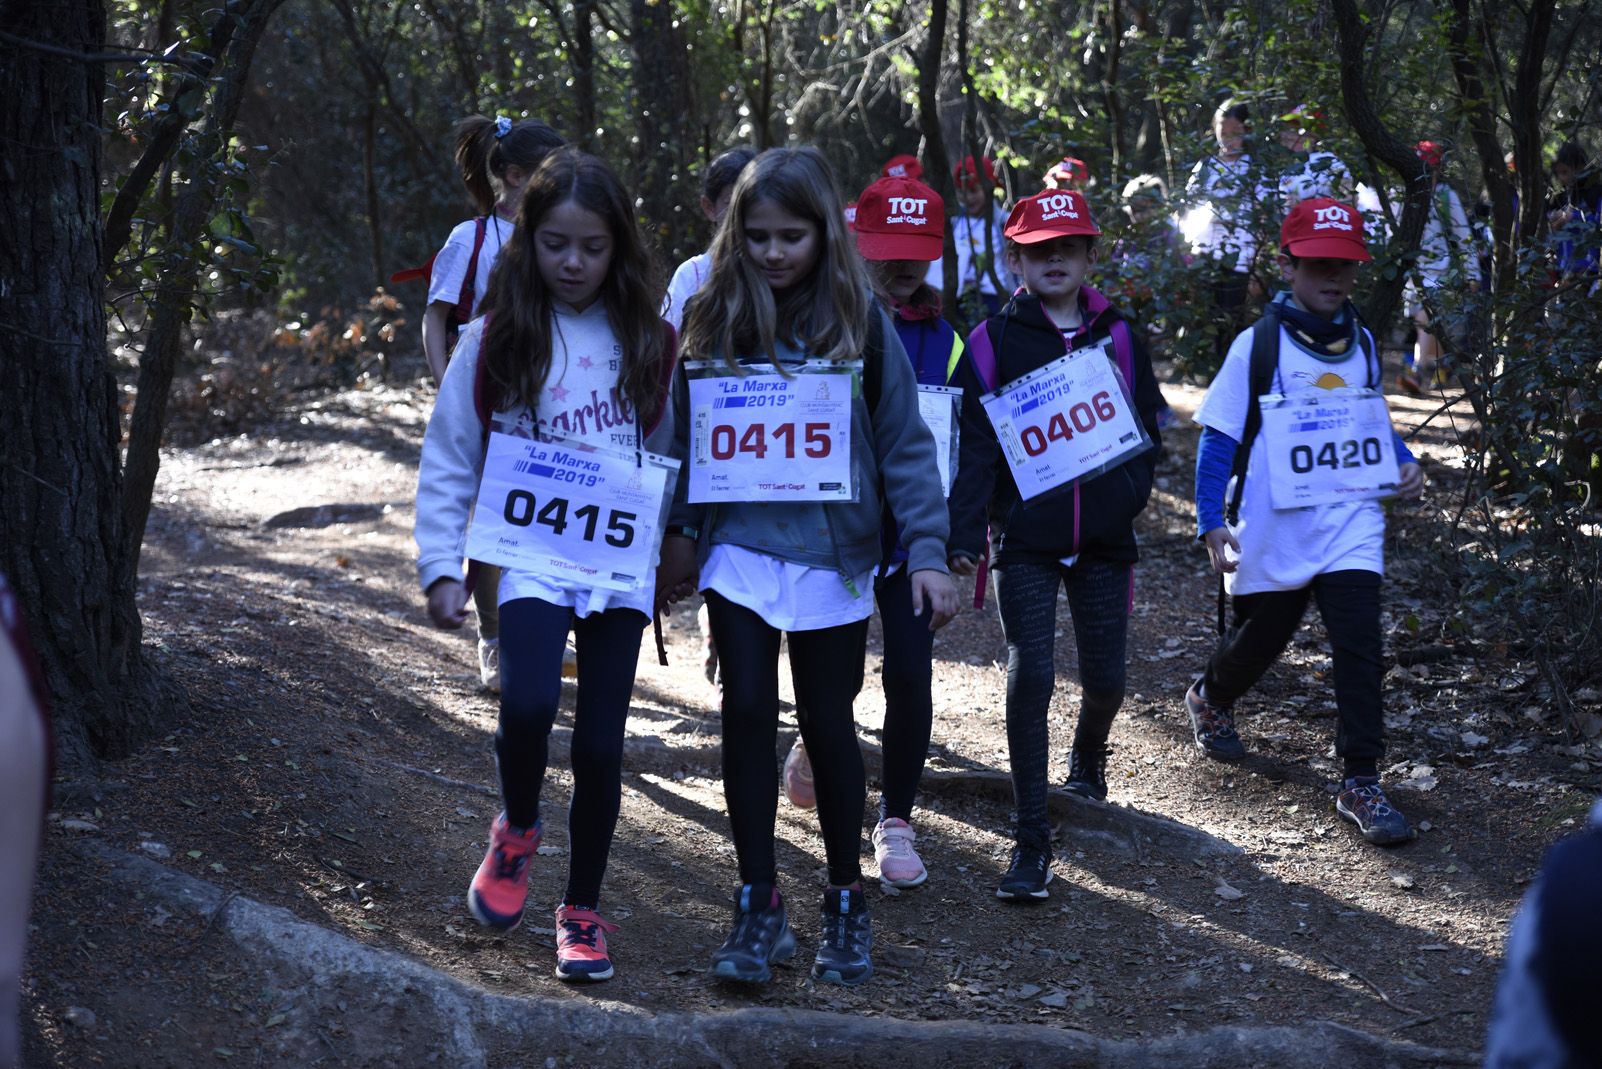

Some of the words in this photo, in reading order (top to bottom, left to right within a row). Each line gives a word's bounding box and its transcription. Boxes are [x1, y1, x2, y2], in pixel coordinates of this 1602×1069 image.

[888, 197, 928, 215] TOT
[1037, 194, 1074, 213] TOT
[1313, 205, 1350, 222] TOT
[743, 380, 787, 392] Marxa
[1029, 372, 1066, 396] Marxa
[1020, 390, 1117, 458] 0406
[711, 422, 832, 461] 0415
[551, 451, 602, 473] Marxa
[1290, 437, 1382, 474] 0420
[503, 488, 638, 548] 0415
